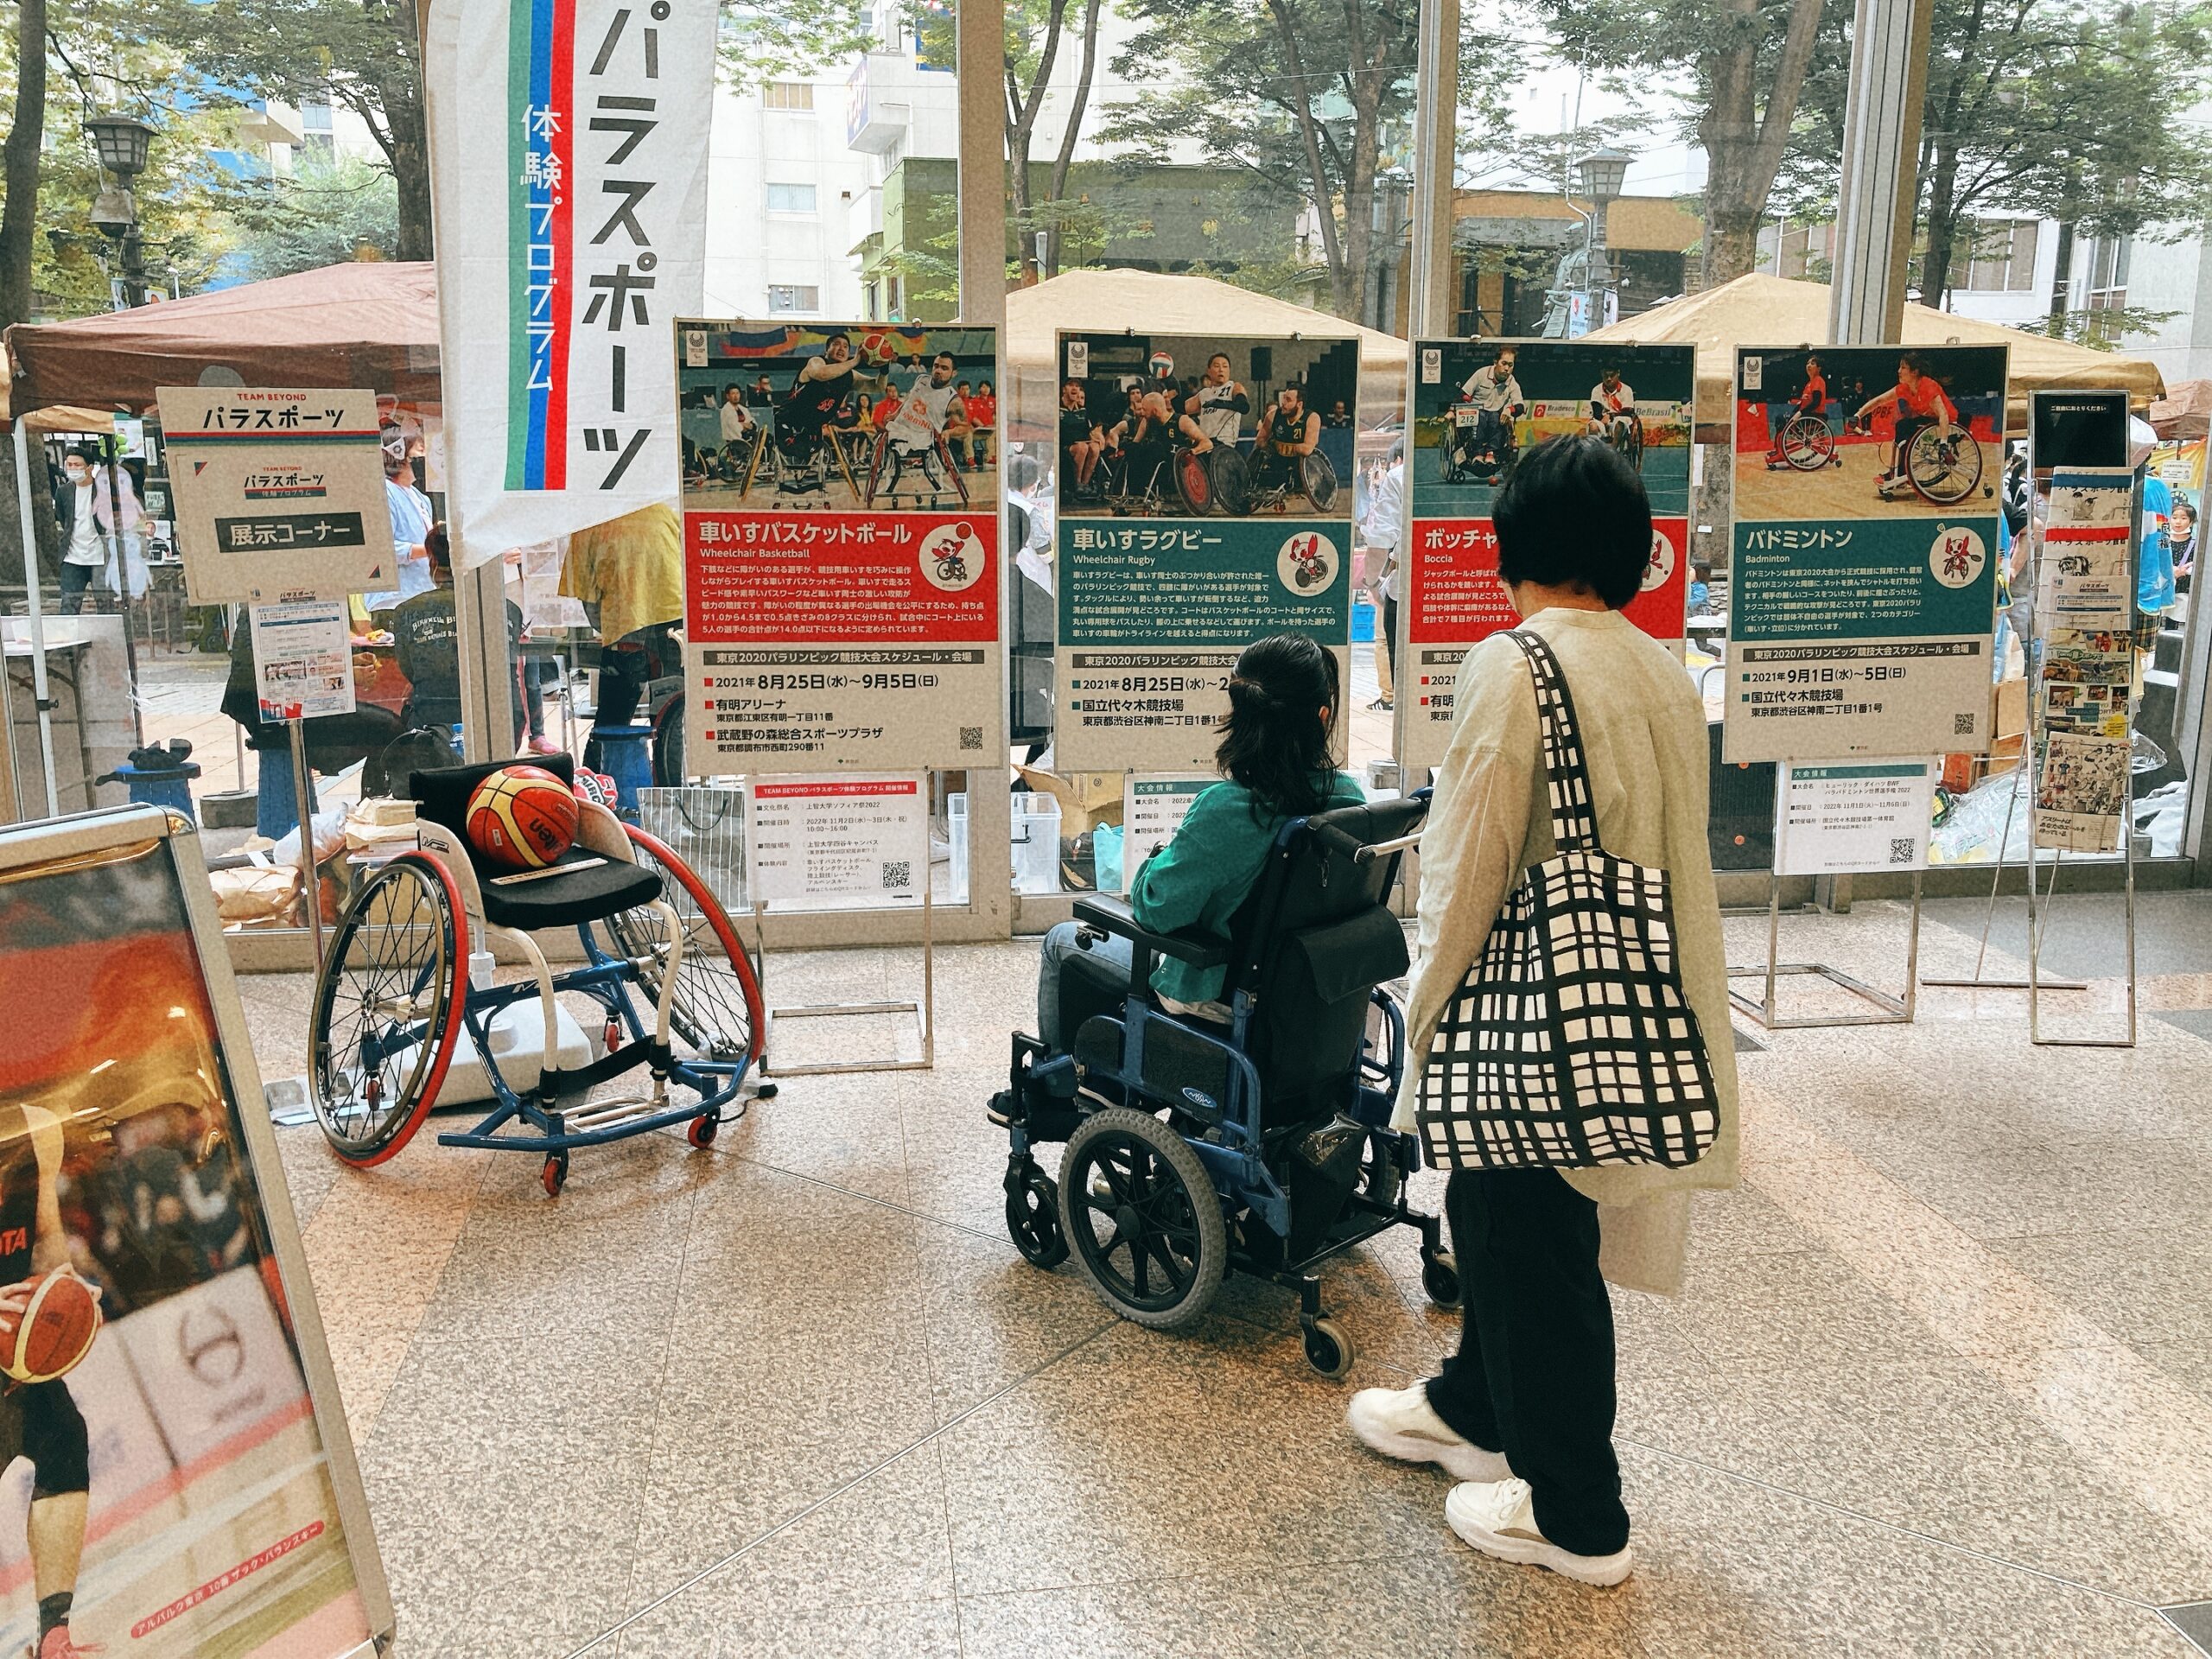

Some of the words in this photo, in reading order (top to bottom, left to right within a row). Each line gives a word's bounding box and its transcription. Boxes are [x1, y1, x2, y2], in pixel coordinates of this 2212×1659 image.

[520, 104, 563, 391] 体験プログラム
[582, 0, 671, 490] パラスポーツ
[203, 405, 344, 429] パラスポーツ
[1460, 415, 1475, 424] 212
[245, 473, 324, 487] パラスポーツ
[231, 522, 351, 546] 展示コーナー
[699, 521, 912, 544] 車いすバスケットボール
[1426, 528, 1497, 550] ボッチャ
[1073, 529, 1222, 550] 車いすラグビー
[1745, 529, 1853, 550] バドミントン
[700, 548, 756, 558] Wheelchair
[759, 548, 810, 558] Basketball
[1424, 555, 1452, 563] Boccia
[1745, 555, 1789, 563] Badminton
[1073, 555, 1125, 564] Wheelchair
[1128, 555, 1155, 566] Rugby
[716, 651, 972, 664] 東京2020パラリンピック競技大会スケジュール・会場
[1754, 644, 1969, 660] 東京2020パラリンピック競技大会スケジュール・会場
[1751, 689, 1843, 703] 国立代々木競技場
[716, 699, 786, 711] 有明アリーナ
[1083, 699, 1184, 712] 国立代々木競技場
[1751, 703, 1883, 717] 東京都渋谷区神南二丁目1番1号
[716, 713, 833, 722] 東京都江東区有明一丁目11番
[1430, 711, 1454, 721] 東京
[717, 728, 883, 741] 武蔵野の森総合スポーツプラザ
[718, 742, 825, 752] 東京都調布市西町290番11
[1794, 770, 1827, 779] 大会情報
[1138, 784, 1173, 792] 大会情報
